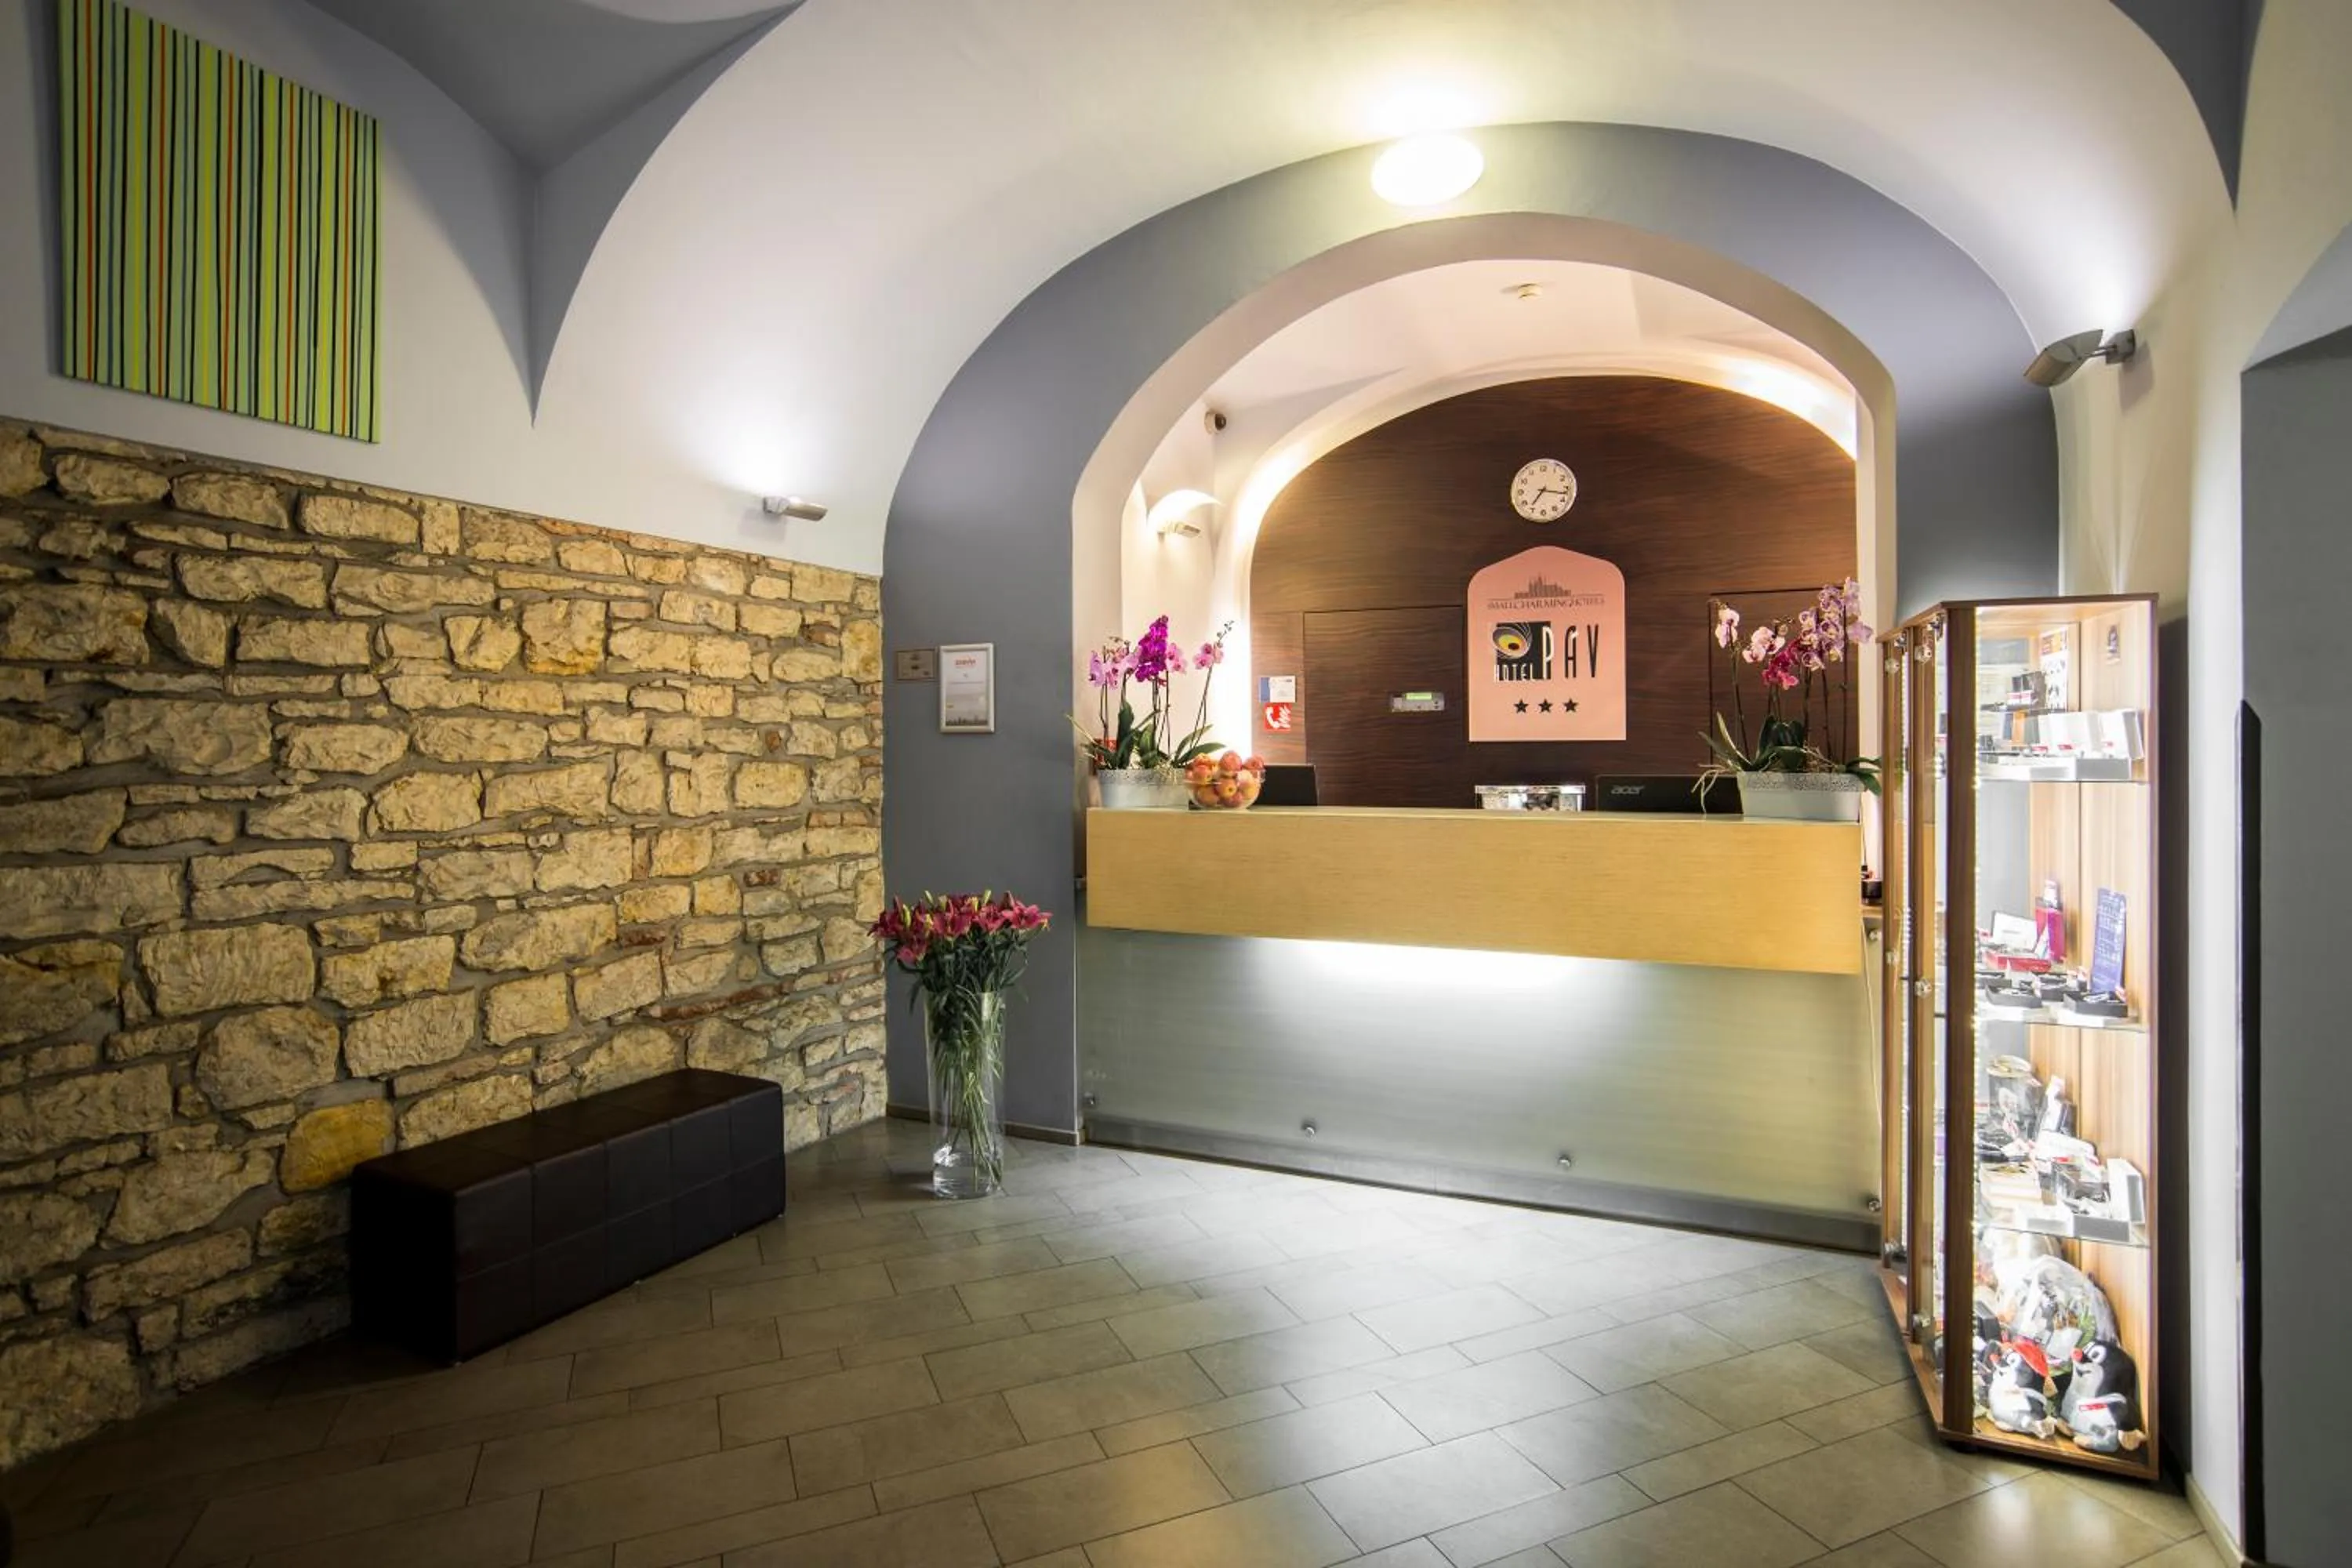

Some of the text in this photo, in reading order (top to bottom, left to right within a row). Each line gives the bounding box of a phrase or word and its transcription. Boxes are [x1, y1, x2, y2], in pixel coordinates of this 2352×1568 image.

[1494, 624, 1599, 682] HOTEL PAV
[1610, 784, 1645, 795] acer
